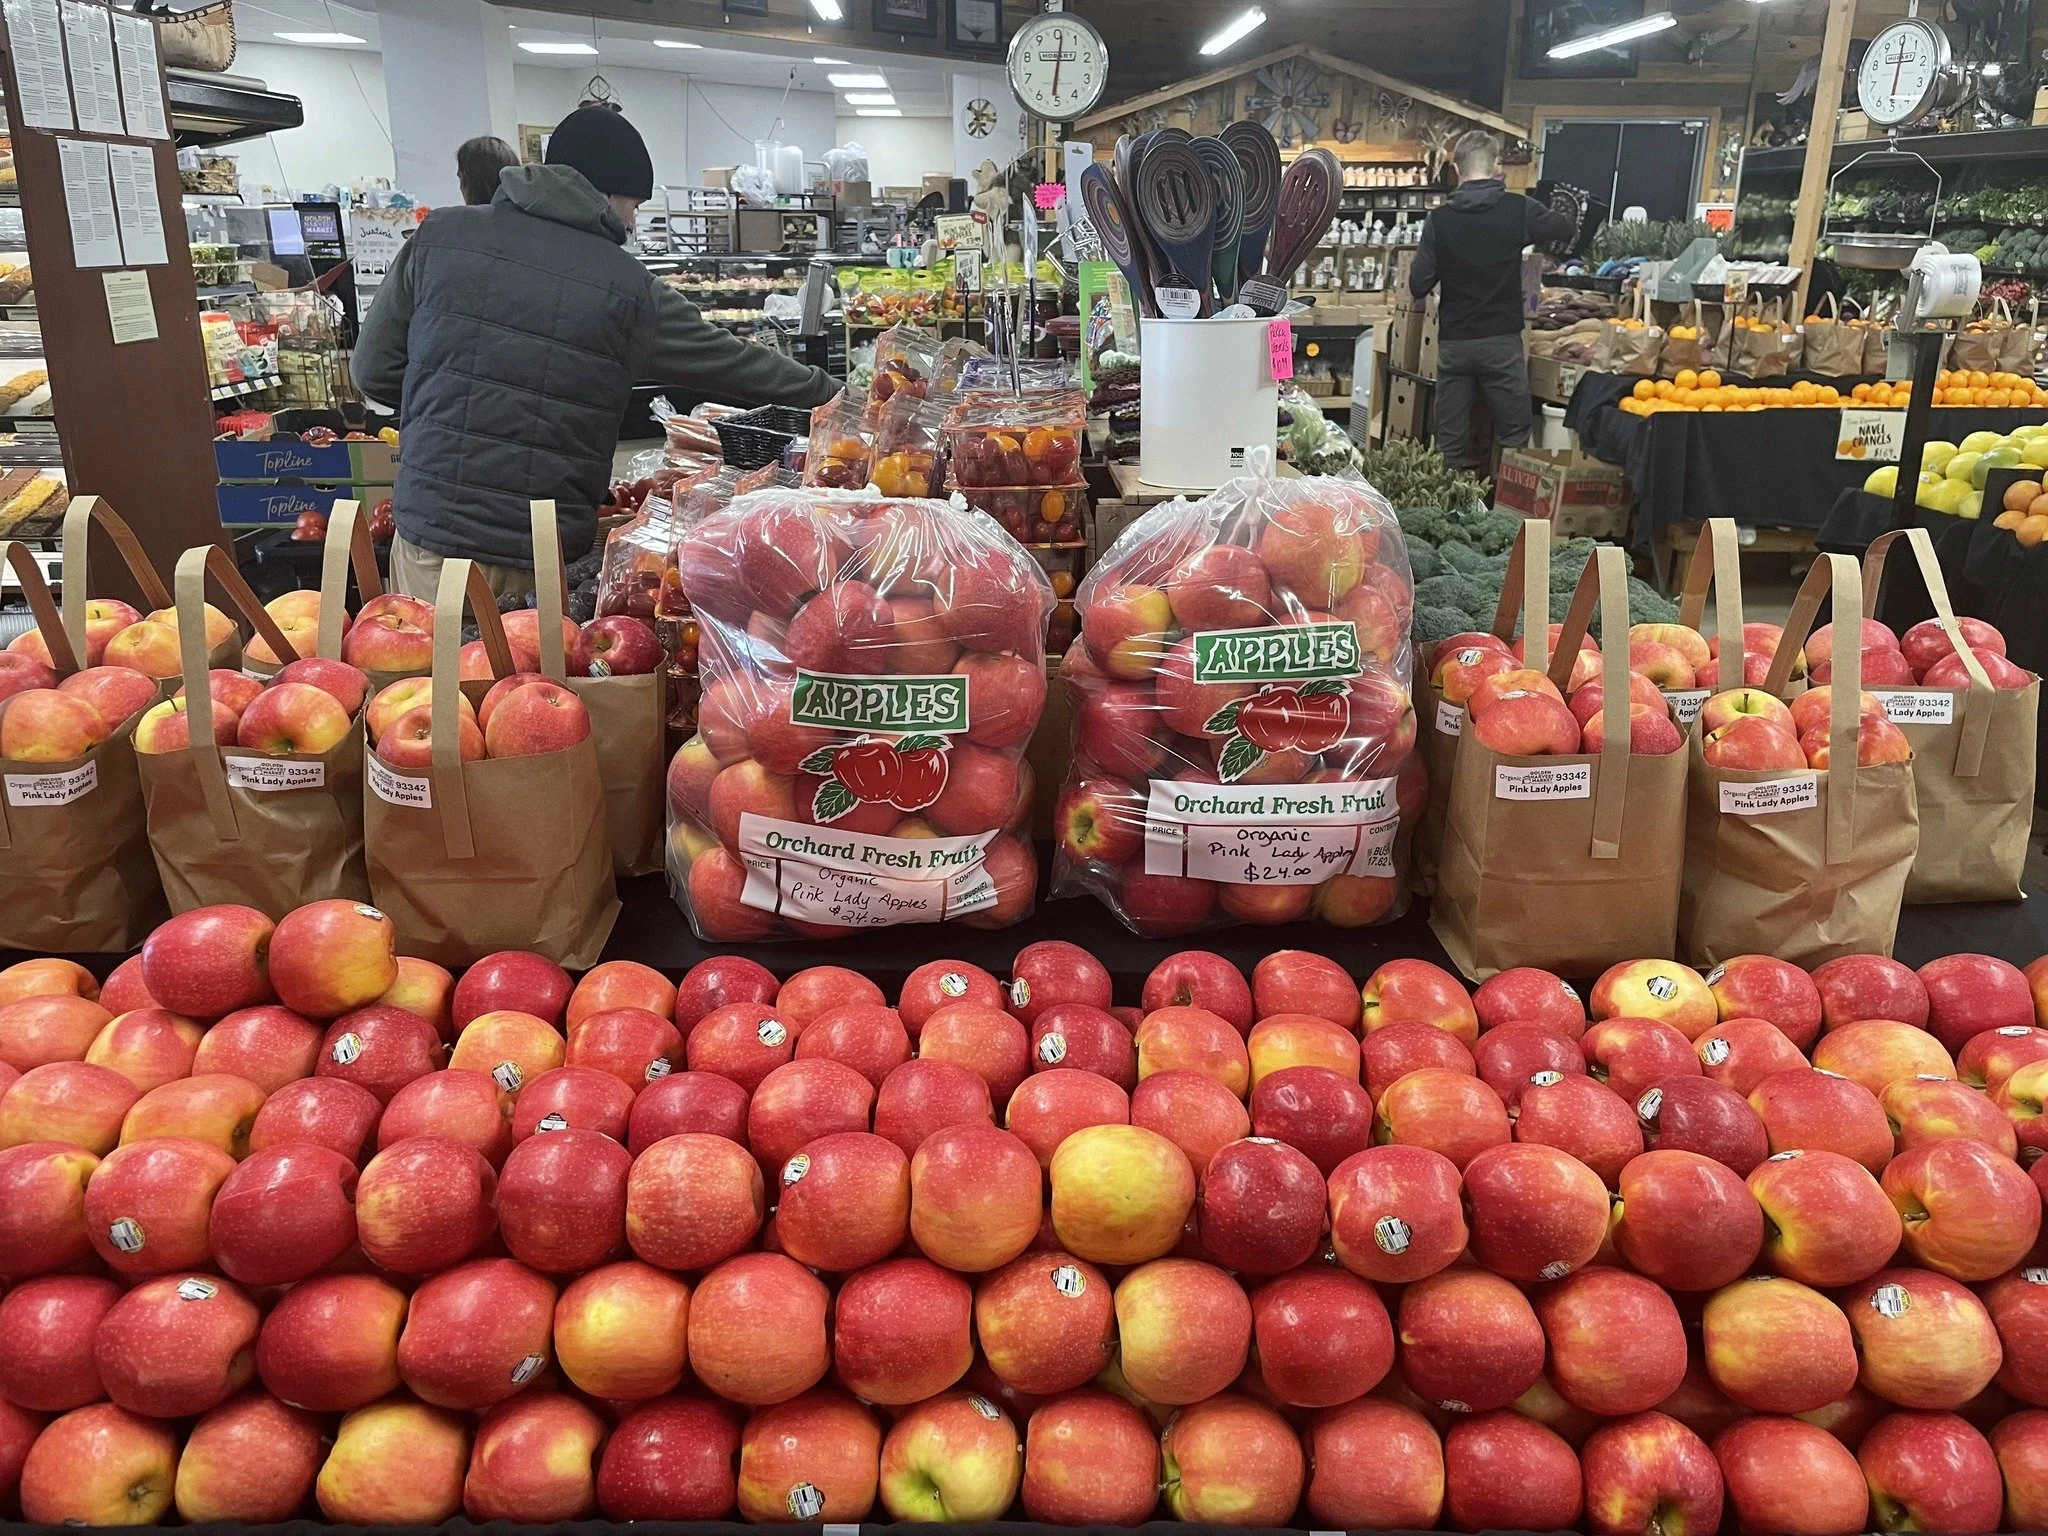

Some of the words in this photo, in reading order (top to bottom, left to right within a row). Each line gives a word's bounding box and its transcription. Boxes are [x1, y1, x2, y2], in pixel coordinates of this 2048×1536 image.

[1054, 29, 1062, 40] 0
[1036, 36, 1043, 46] 9
[1073, 35, 1078, 46] 1
[1885, 43, 1890, 52] 9
[1024, 52, 1031, 62] 8
[1083, 52, 1091, 63] 2
[1920, 56, 1926, 66] 2
[1872, 60, 1878, 71] 8
[1025, 73, 1032, 84] 7
[1084, 74, 1090, 84] 3
[1917, 77, 1923, 87] 3
[1870, 81, 1876, 92] 7
[1036, 90, 1043, 100] 6
[1070, 90, 1078, 100] 4
[1054, 96, 1060, 106] 5
[1876, 97, 1882, 108] 6
[360, 227, 393, 238] Justin's
[1859, 424, 1884, 436] NAVEL
[1852, 434, 1891, 448] ORANGES
[255, 450, 312, 476] Topline
[259, 495, 318, 520] Topline
[1201, 631, 1354, 674] APPLES
[799, 680, 960, 724] APPLES
[1679, 709, 1696, 717] Appl
[1894, 709, 1914, 718] Lady
[1916, 709, 1945, 718] Apples
[1445, 720, 1460, 730] Pink
[68, 766, 94, 786] 93342
[288, 768, 320, 776] 93342
[1556, 772, 1586, 781] 93342
[241, 774, 260, 784] Pink
[262, 777, 284, 786] Lady
[1500, 774, 1522, 782] Organic
[10, 782, 32, 790] Organic
[44, 791, 66, 799] Lady
[68, 779, 92, 796] Apples
[396, 782, 426, 792] 93342
[1509, 784, 1528, 792] Pink
[1530, 785, 1550, 793] Lady
[1552, 784, 1582, 792] Apples
[1782, 782, 1814, 794] 93342
[380, 784, 394, 798] Lady
[395, 791, 423, 801] Apples
[1724, 790, 1746, 798] Organic
[1174, 795, 1264, 814] Orchard
[1271, 792, 1333, 814] Fresh
[1341, 790, 1386, 812] Fruit
[1735, 800, 1754, 808] Pink
[1757, 799, 1778, 808] Lady
[1780, 794, 1810, 805] Apples
[1152, 826, 1178, 836] PRICE
[765, 832, 854, 860] Orchard
[861, 846, 922, 868] Fresh
[928, 845, 979, 868] Fruit
[1208, 842, 1250, 858] Pink
[1272, 849, 1310, 864] Lady
[747, 858, 772, 870] PRICE
[1368, 856, 1388, 866] 17.62
[819, 867, 879, 888] Organic
[1244, 862, 1312, 882] $24.00
[791, 882, 824, 902] Pink
[834, 892, 870, 910] Lady
[878, 893, 928, 910] Apples
